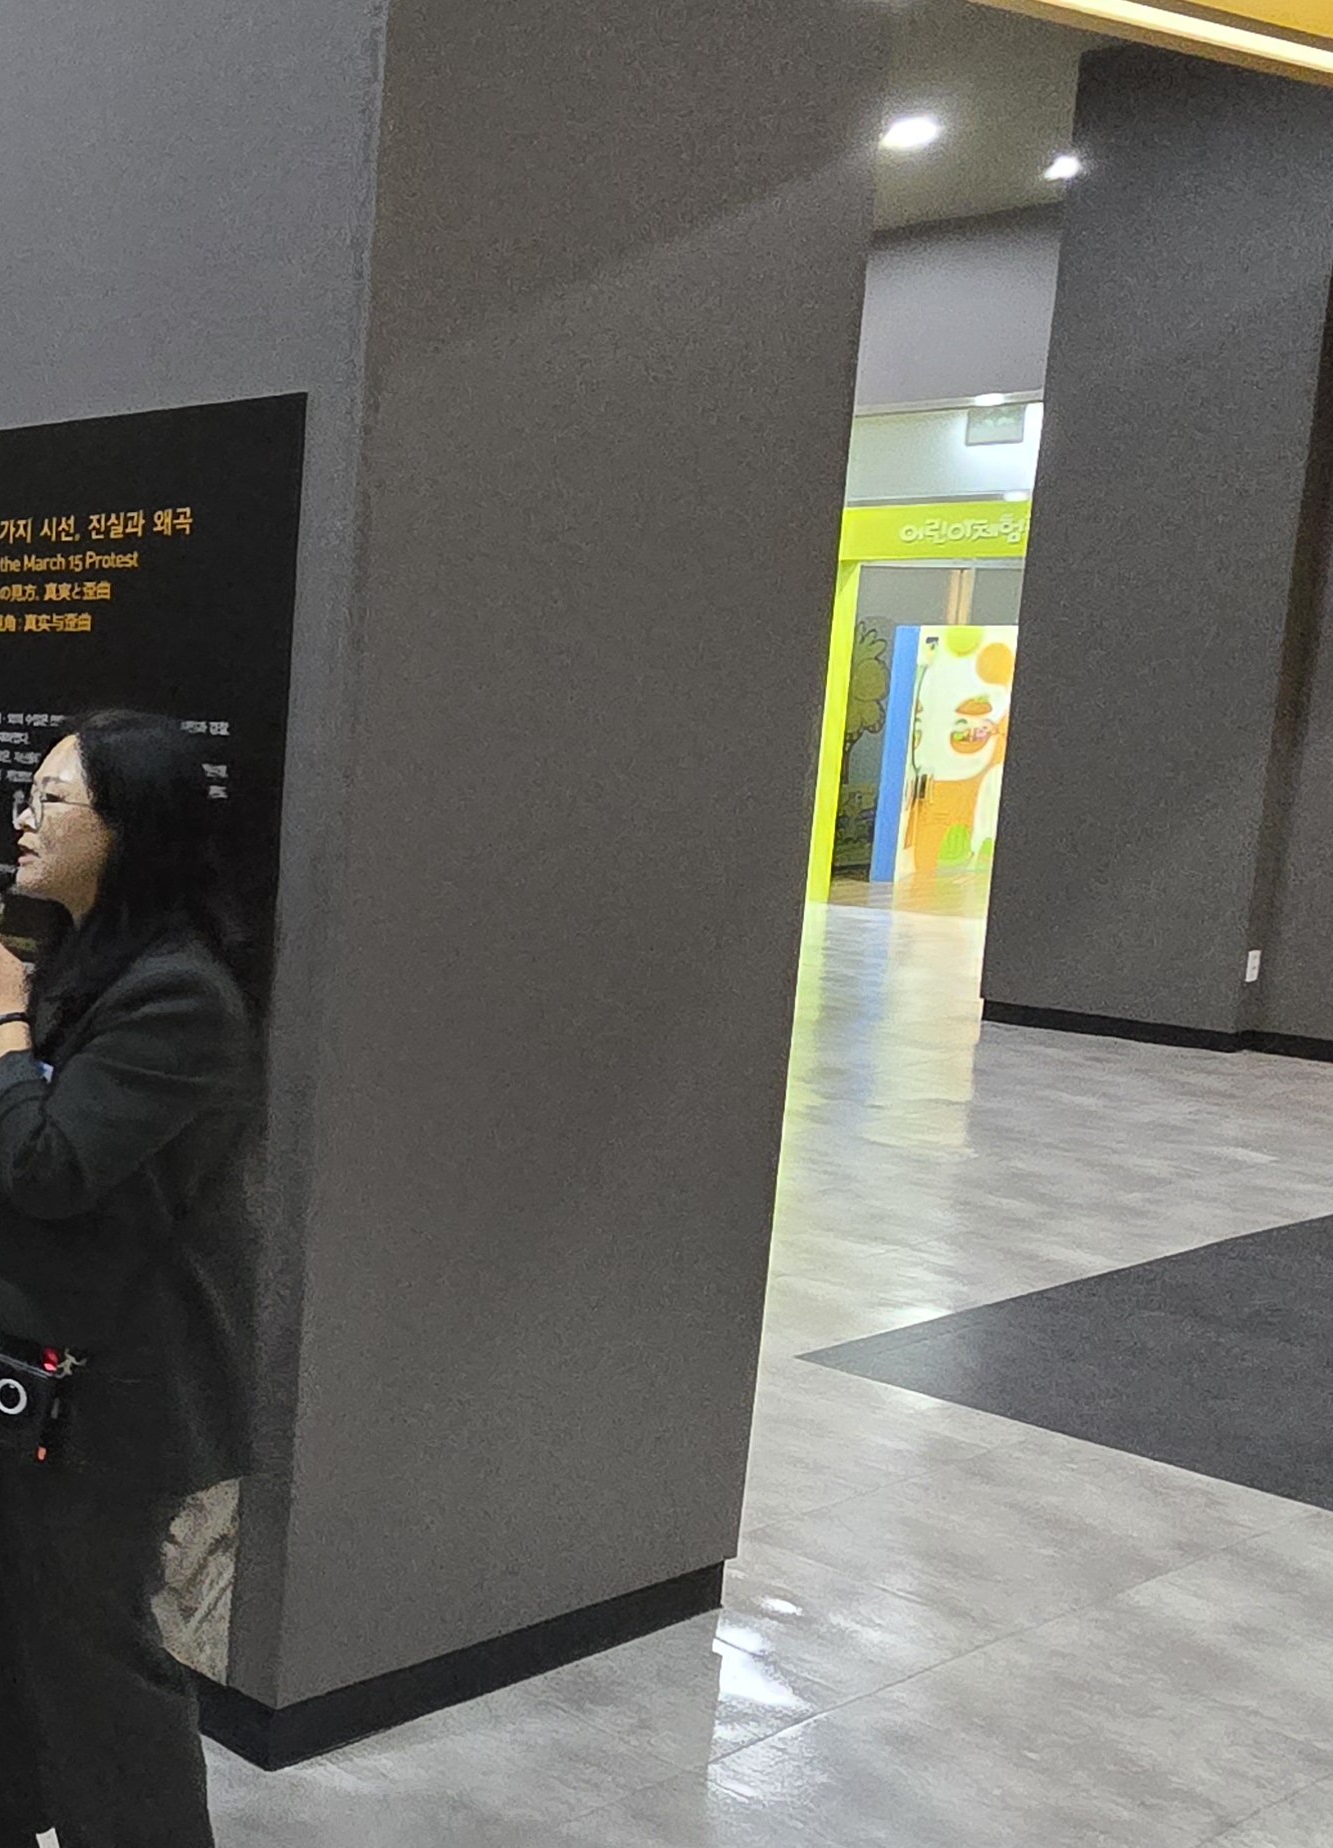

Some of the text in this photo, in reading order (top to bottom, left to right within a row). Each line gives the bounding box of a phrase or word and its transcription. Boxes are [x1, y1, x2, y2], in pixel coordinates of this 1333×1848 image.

[87, 510, 145, 540] 진실과
[152, 506, 193, 537] 왜곡
[0, 555, 21, 573] the
[23, 552, 66, 572] March
[68, 554, 83, 573] 15
[85, 549, 138, 570] Protest
